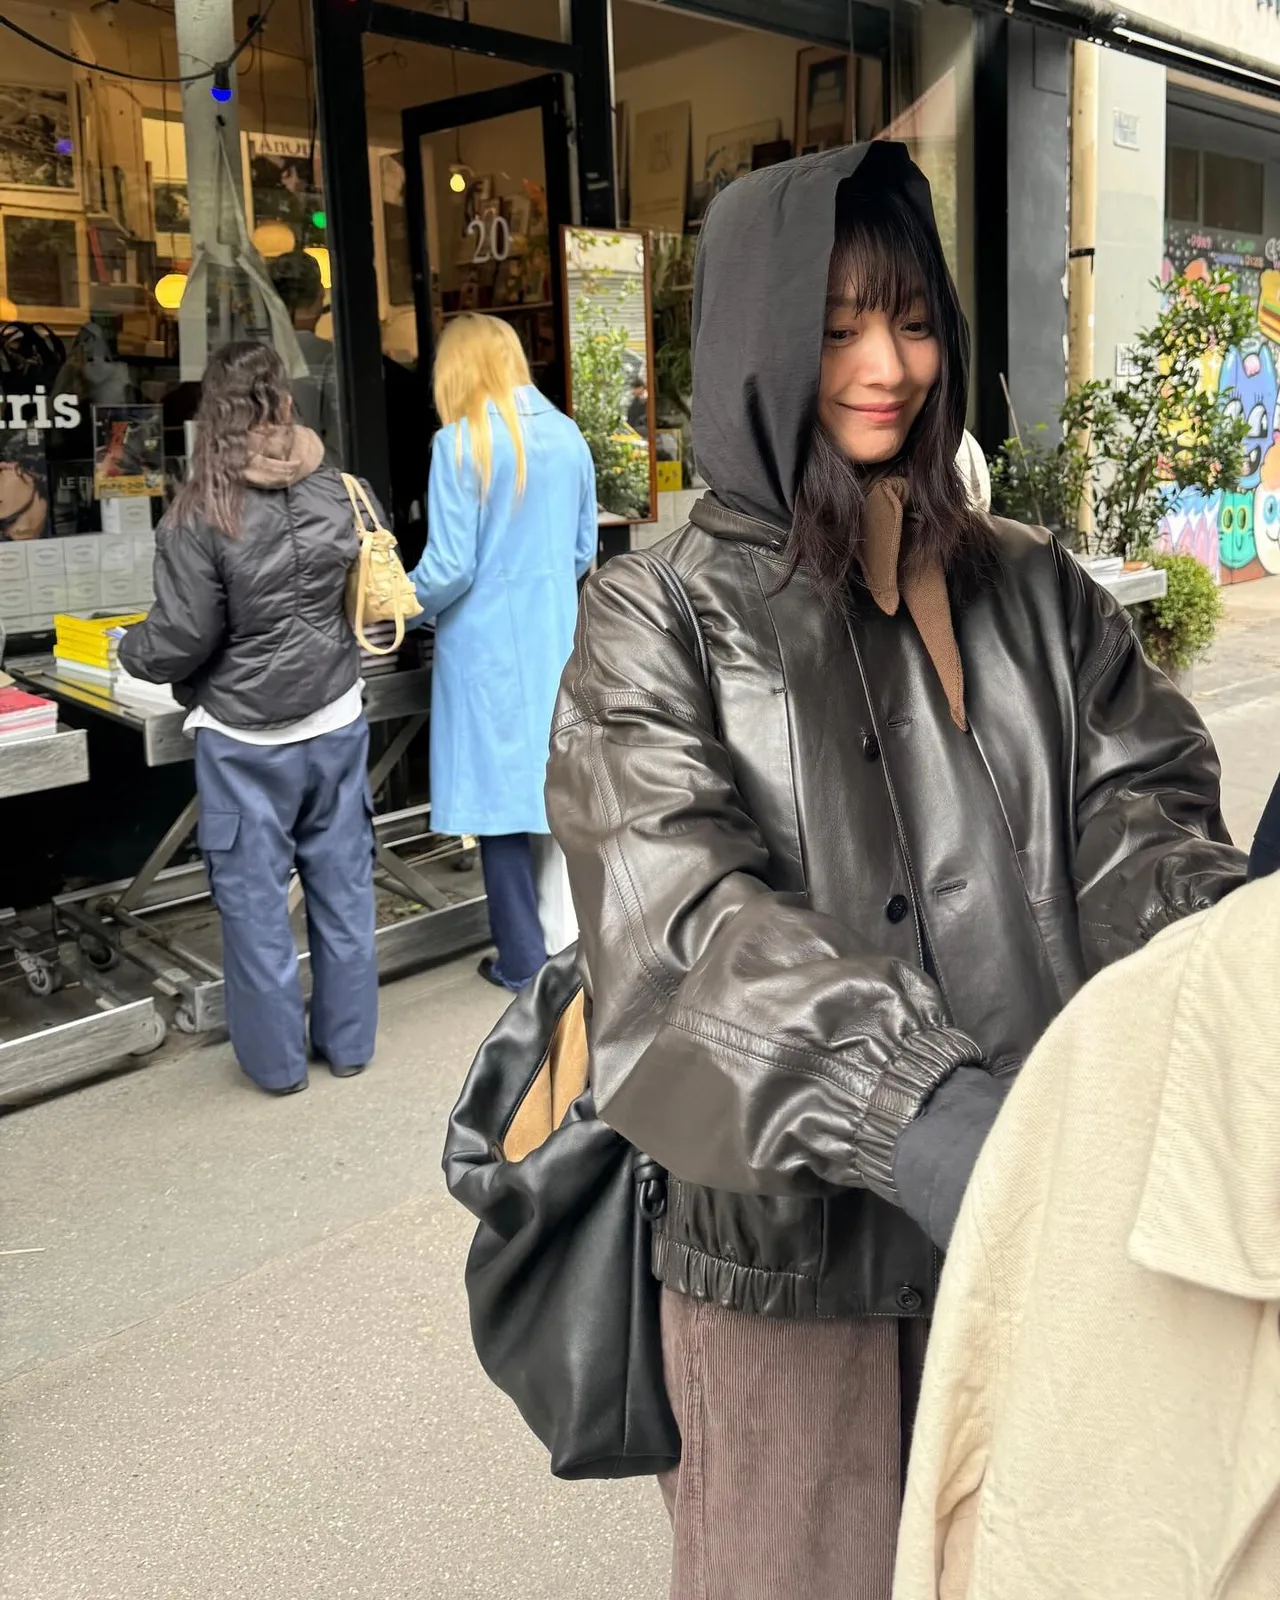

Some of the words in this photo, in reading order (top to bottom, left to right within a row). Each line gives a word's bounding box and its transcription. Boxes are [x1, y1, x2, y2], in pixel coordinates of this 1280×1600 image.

[467, 215, 510, 264] 20
[0, 384, 81, 429] ris
[59, 477, 76, 490] LE
